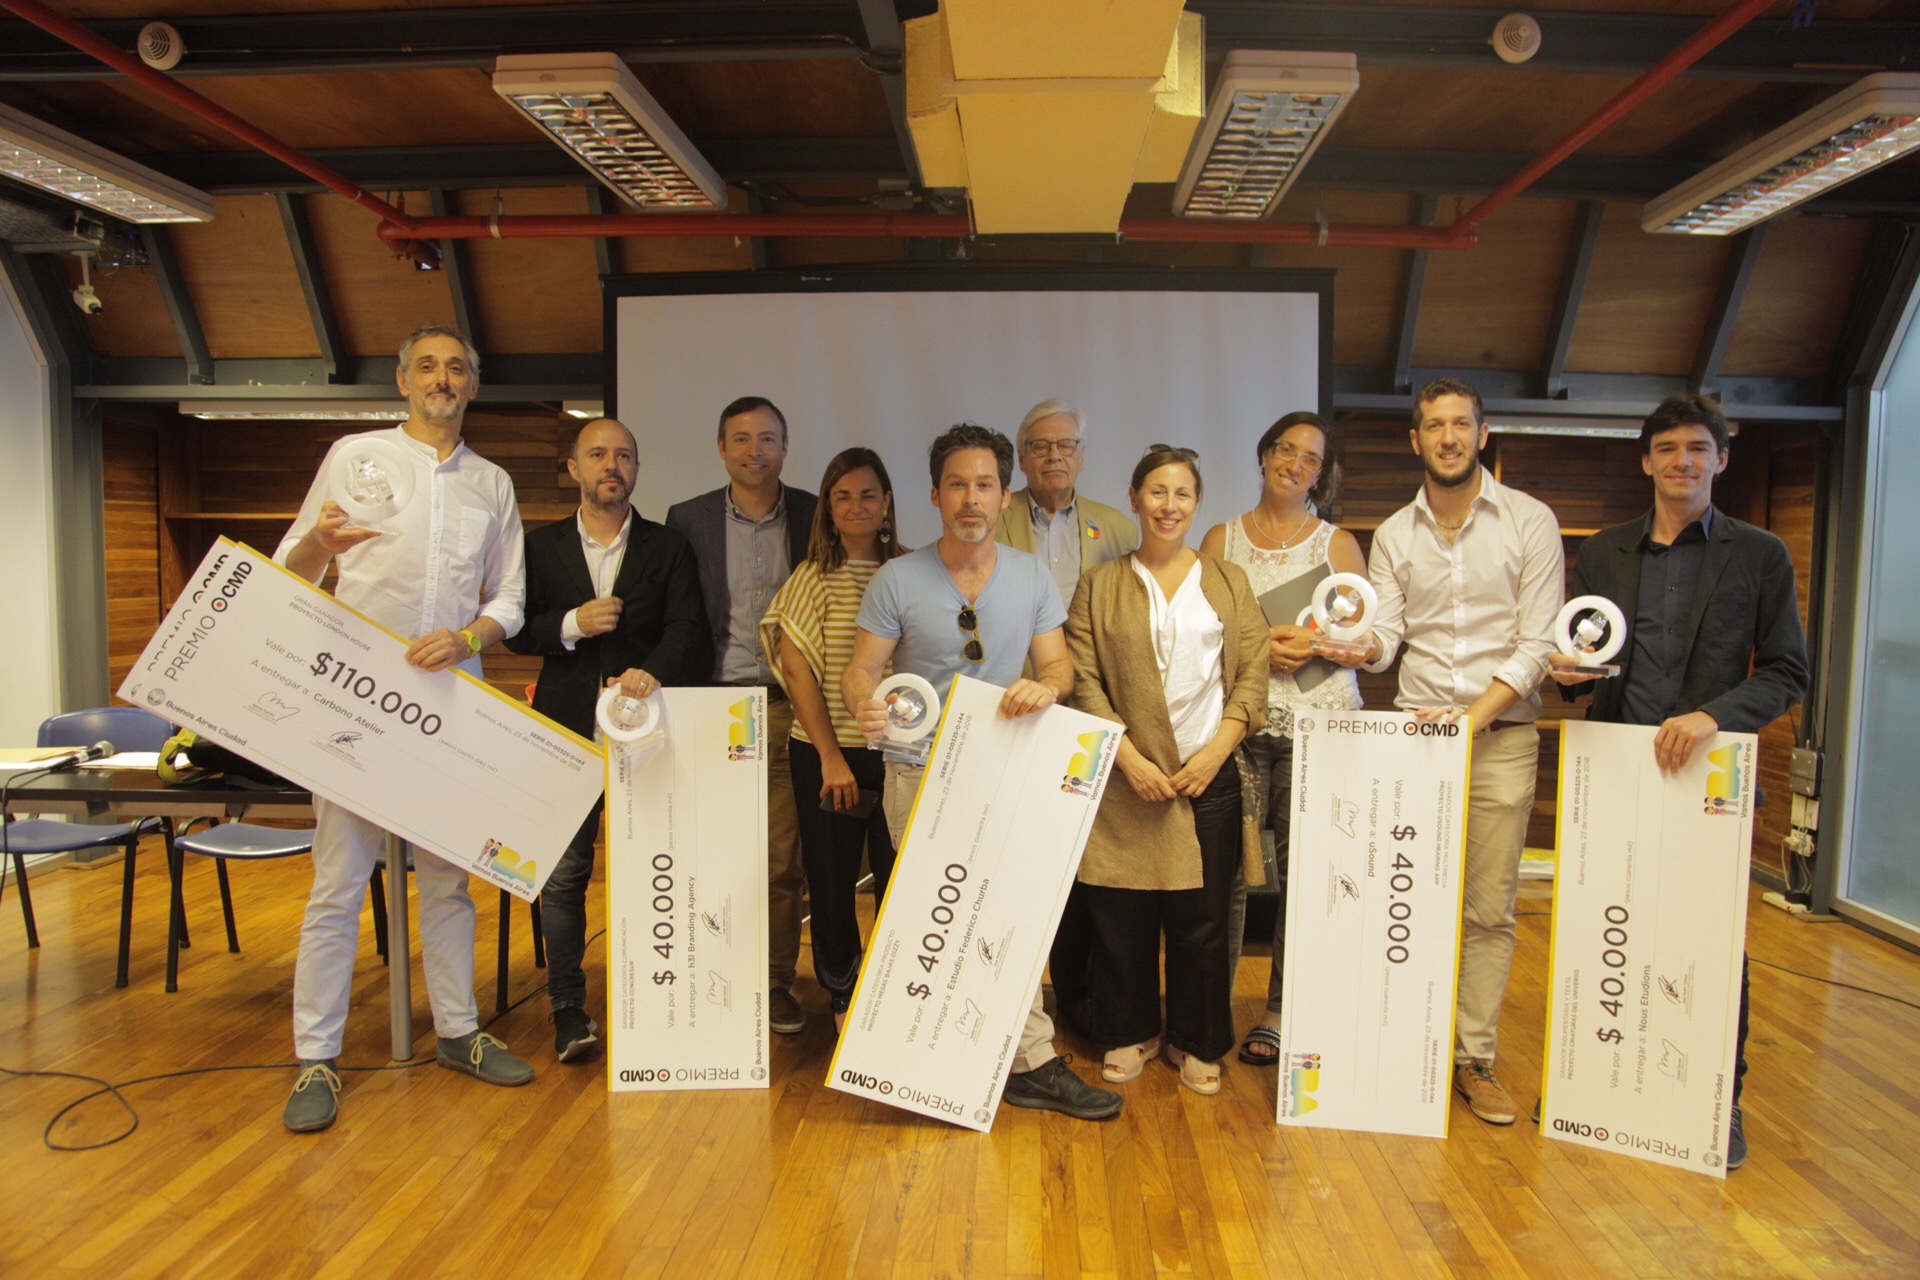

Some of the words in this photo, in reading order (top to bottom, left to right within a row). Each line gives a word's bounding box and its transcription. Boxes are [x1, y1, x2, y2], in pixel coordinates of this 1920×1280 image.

[164, 615, 216, 681] PREMIO
[221, 561, 252, 598] CMD
[265, 637, 285, 654] Vale
[285, 652, 306, 664] por:
[310, 652, 442, 736] $110.000
[261, 666, 301, 689] entregar
[313, 693, 353, 719] Carbono
[354, 716, 385, 736] Atelier
[165, 700, 195, 720] Buenos
[195, 716, 218, 731] Aires
[219, 728, 248, 746] Ciudad
[1327, 719, 1398, 735] PREMIO
[1420, 723, 1459, 737] CMD
[1300, 734, 1310, 762] Buenos
[1744, 742, 1752, 764] Aires
[1090, 779, 1102, 800] Vamos
[1098, 753, 1110, 777] Buenos
[1107, 733, 1117, 751] Aires
[1300, 764, 1308, 784] Aires
[1742, 764, 1750, 792] Buenos
[1298, 784, 1308, 812] Ciudad
[1394, 778, 1404, 800] Vale
[1368, 788, 1378, 828] entregar
[1392, 800, 1402, 820] por:
[1740, 794, 1750, 818] Vamos
[1367, 841, 1377, 878] uSound
[472, 863, 491, 876] Vamos
[492, 873, 513, 888] Buenos
[514, 885, 530, 896] Aires
[686, 876, 696, 910] Agency
[652, 854, 674, 959] 40.000
[917, 863, 968, 973] 40.000
[1386, 852, 1414, 964] 40.000
[686, 912, 696, 952] Branding
[932, 1002, 948, 1040] entregar
[946, 955, 964, 990] Estudio
[958, 914, 978, 954] Federico
[972, 878, 990, 912] Churba
[1600, 905, 1629, 1017] 40.000
[668, 990, 676, 1008] por:
[1640, 965, 1651, 1006] Etudions
[688, 980, 698, 1020] entregar
[914, 1004, 924, 1024] por:
[666, 1008, 676, 1028] Vale
[1638, 1008, 1648, 1032] Nous
[905, 1024, 918, 1043] Vale
[754, 1038, 762, 1066] Buenos
[1612, 1048, 1622, 1068] por:
[1636, 1046, 1646, 1084] entregar
[620, 1069, 655, 1082] CMD
[675, 1068, 739, 1081] PREMIO
[841, 1070, 878, 1089] CMD
[982, 1082, 996, 1108] Buenos
[992, 1062, 1003, 1081] Aires
[998, 1034, 1012, 1060] Ciudad
[1610, 1068, 1620, 1088] Vale
[1282, 1074, 1290, 1098] Buenos
[1714, 1073, 1724, 1101] Ciudad
[898, 1086, 964, 1116] PREMIO
[1280, 1100, 1288, 1118] Aires
[1712, 1102, 1722, 1124] Aires
[1553, 1119, 1592, 1137] CMD
[1710, 1124, 1720, 1151] Buenos
[1615, 1132, 1689, 1160] PREMIO
